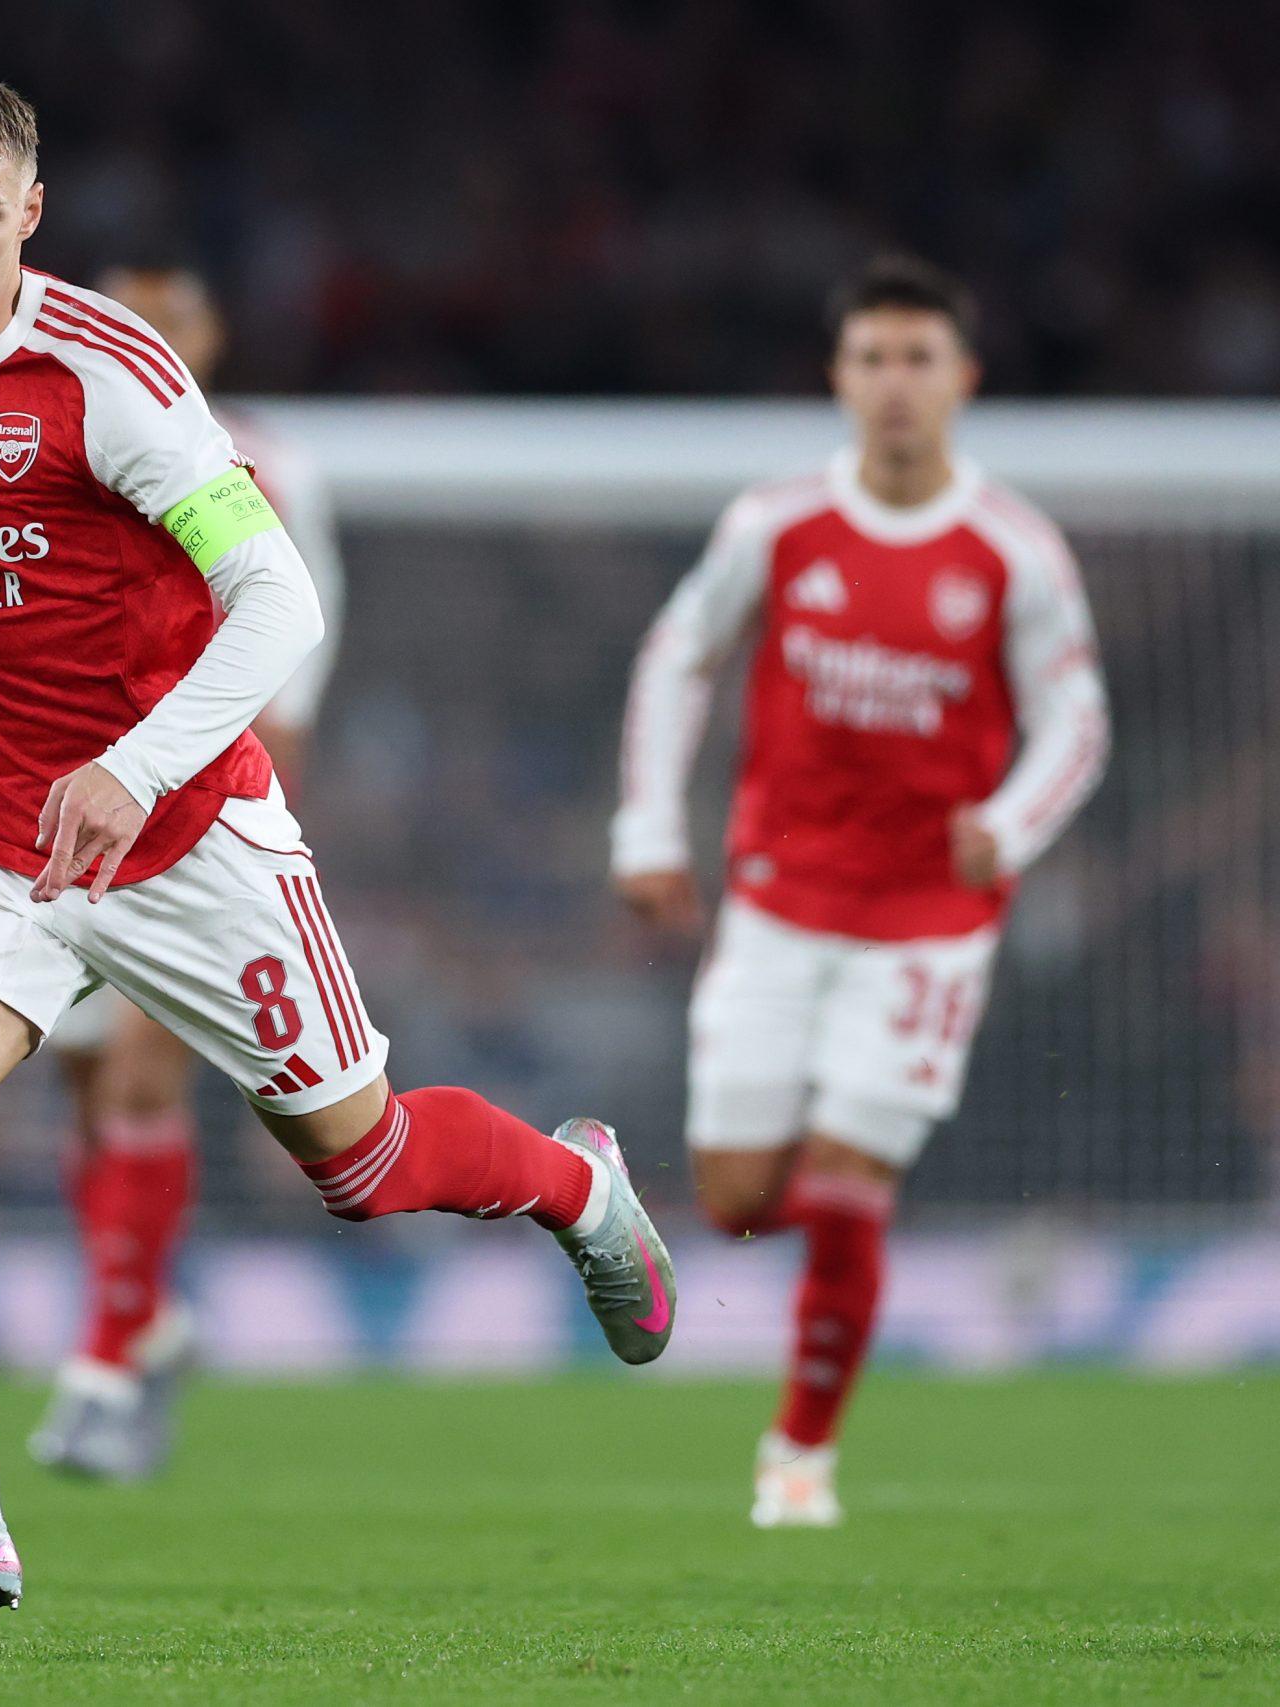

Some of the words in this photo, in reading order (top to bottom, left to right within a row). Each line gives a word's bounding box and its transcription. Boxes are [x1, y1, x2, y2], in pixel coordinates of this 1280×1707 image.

[209, 487, 231, 503] NO
[230, 481, 247, 492] TO
[238, 953, 304, 1053] 8
